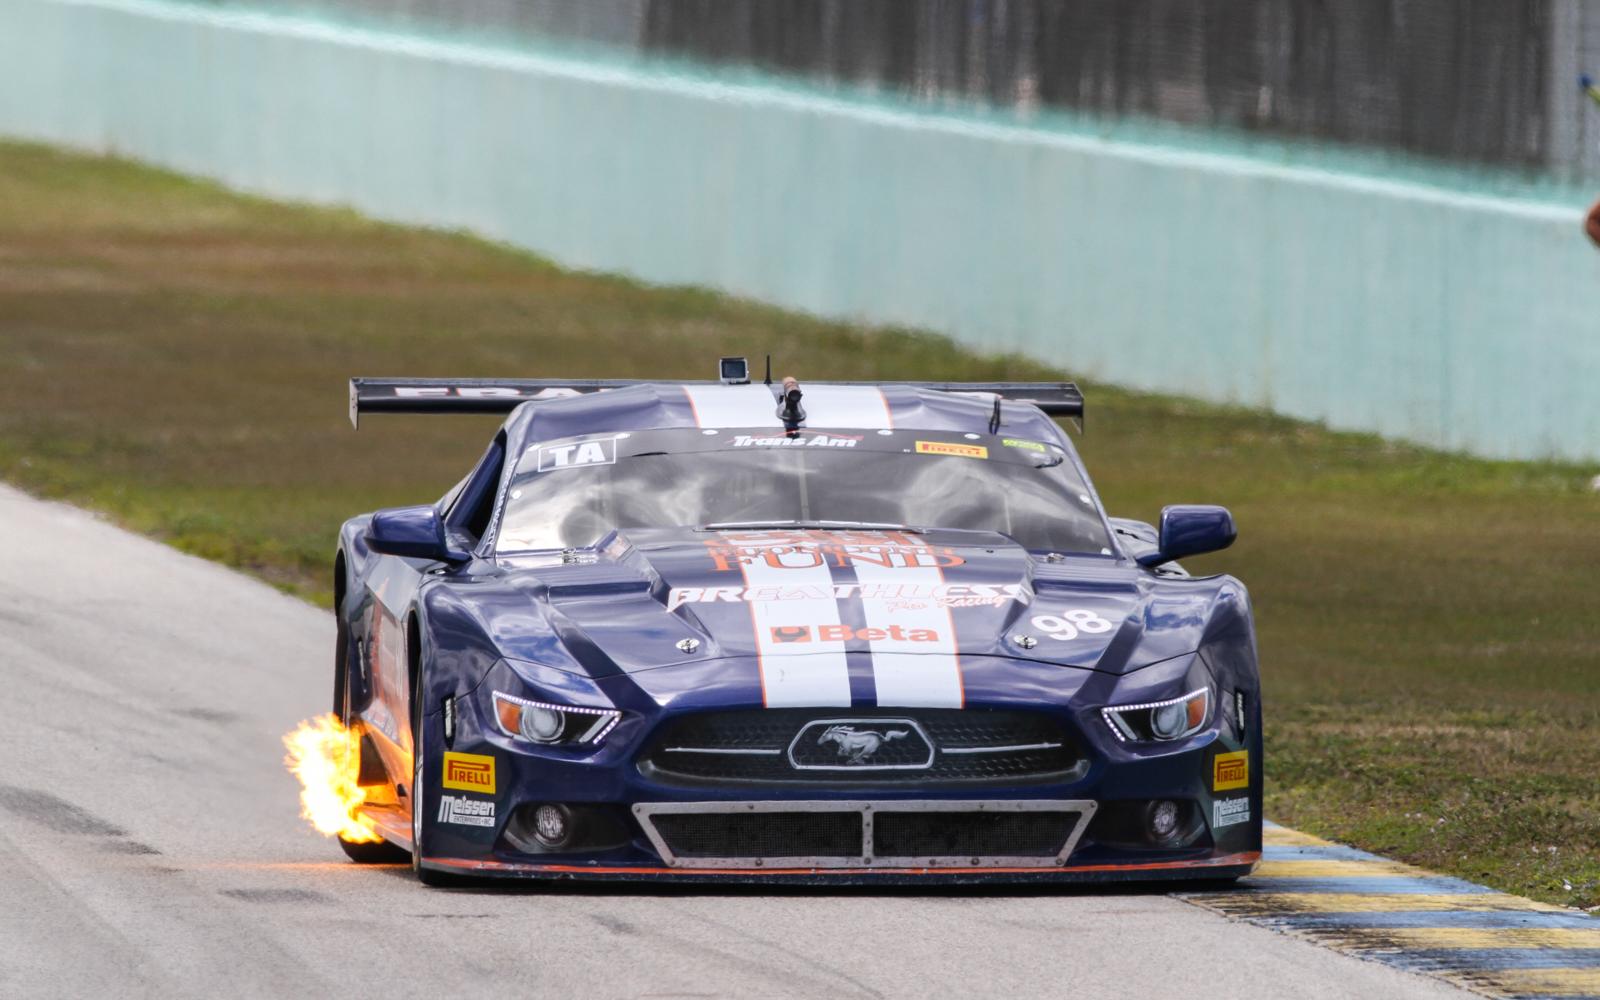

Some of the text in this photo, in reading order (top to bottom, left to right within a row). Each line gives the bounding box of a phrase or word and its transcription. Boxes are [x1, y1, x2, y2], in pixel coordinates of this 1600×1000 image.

[549, 442, 606, 466] TA
[733, 435, 857, 447] Trans Am
[666, 584, 1029, 613] BREATHLESS
[819, 624, 939, 643] Beta
[1031, 609, 1113, 642] 98
[448, 759, 491, 786] PIRELLI
[1217, 758, 1246, 784] PIRELLI
[437, 795, 496, 823] Meissen
